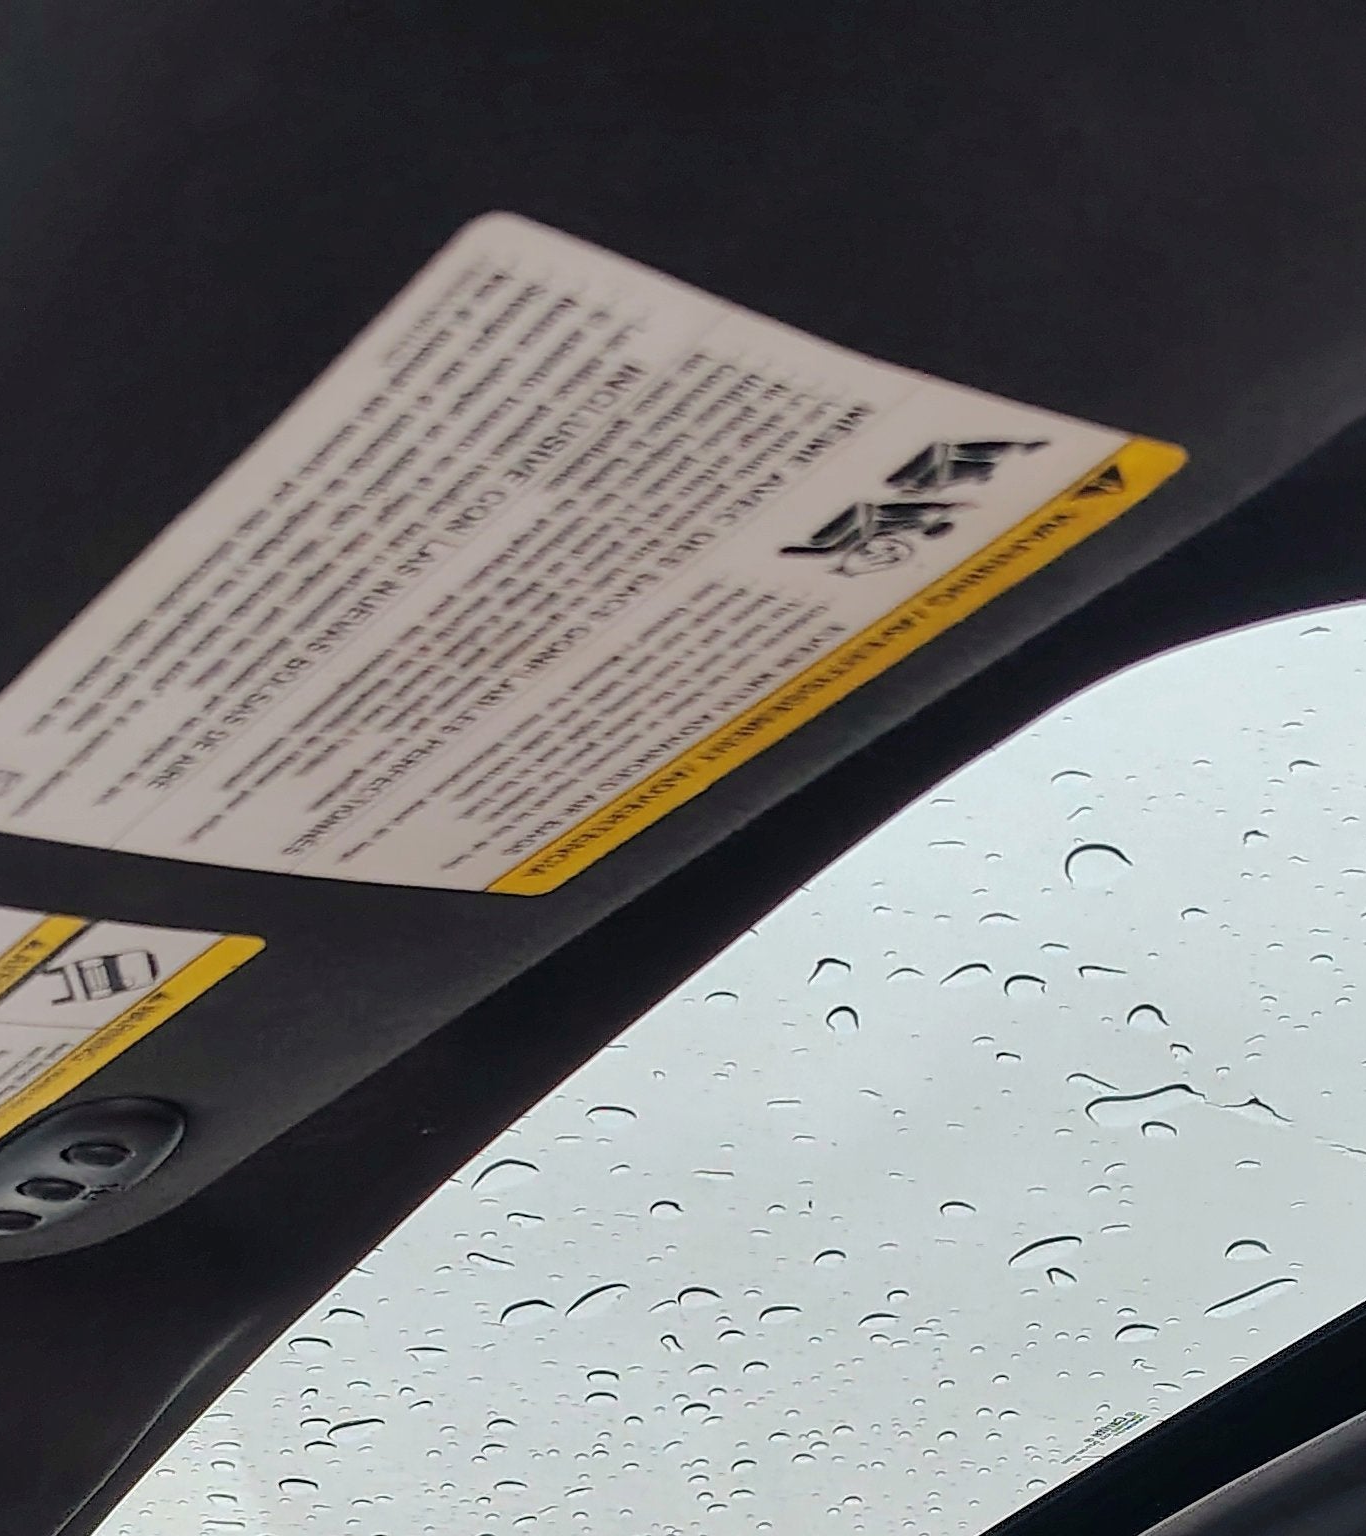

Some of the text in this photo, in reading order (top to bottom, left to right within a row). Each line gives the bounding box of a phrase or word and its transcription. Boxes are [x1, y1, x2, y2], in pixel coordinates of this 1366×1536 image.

[648, 529, 717, 569] DES
[702, 471, 791, 529] AVEC
[140, 361, 653, 792] INCLUSIVE CON LAS NUEVAS BOLSAS DE AIRE
[579, 570, 663, 623] SACS
[921, 510, 1078, 609] WARNING
[433, 625, 593, 736] GONFLABLES
[495, 623, 846, 857] EVEN WITH ADVANCED AIR BAGS
